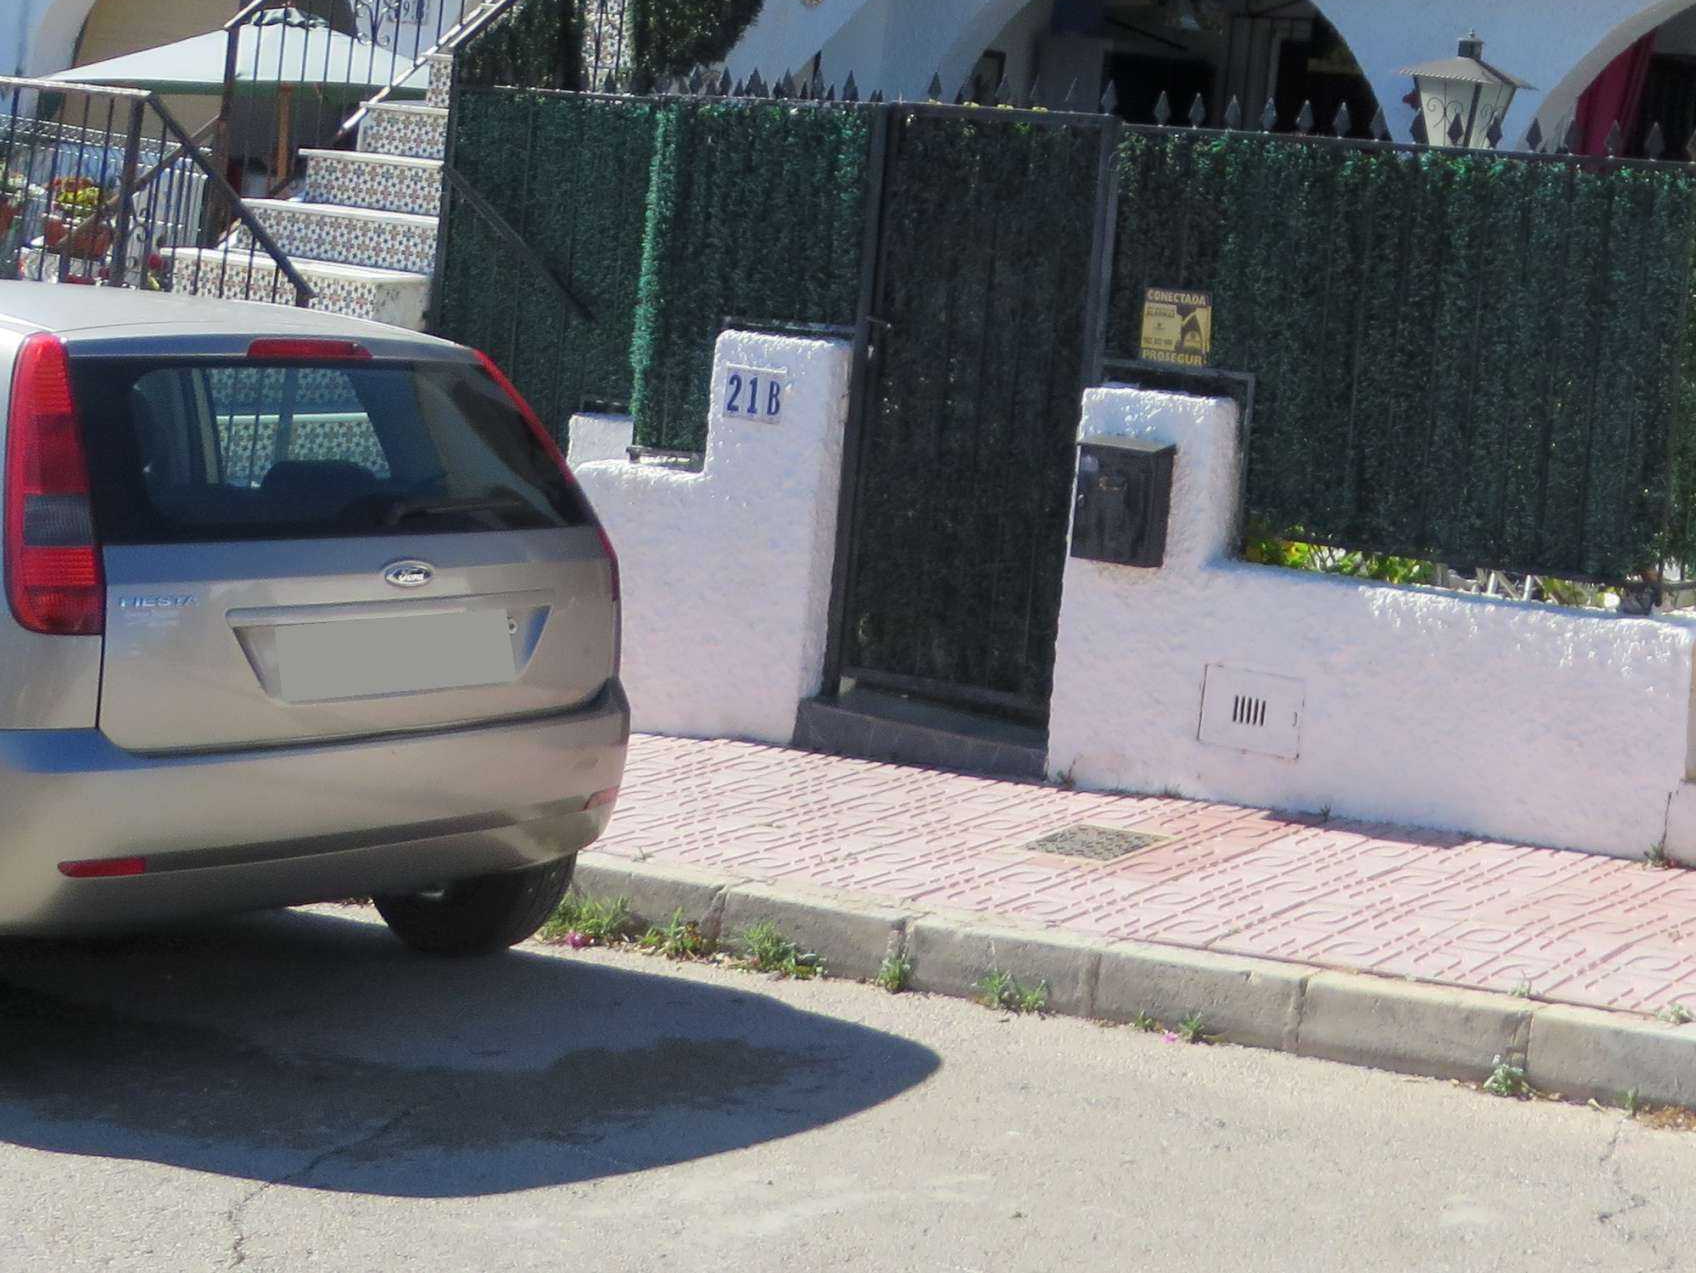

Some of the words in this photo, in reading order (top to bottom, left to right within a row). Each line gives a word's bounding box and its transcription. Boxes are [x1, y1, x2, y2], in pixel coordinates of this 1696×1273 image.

[1147, 289, 1206, 305] CONECTADA
[1142, 349, 1203, 365] PROSEGUR
[727, 374, 780, 415] 21B
